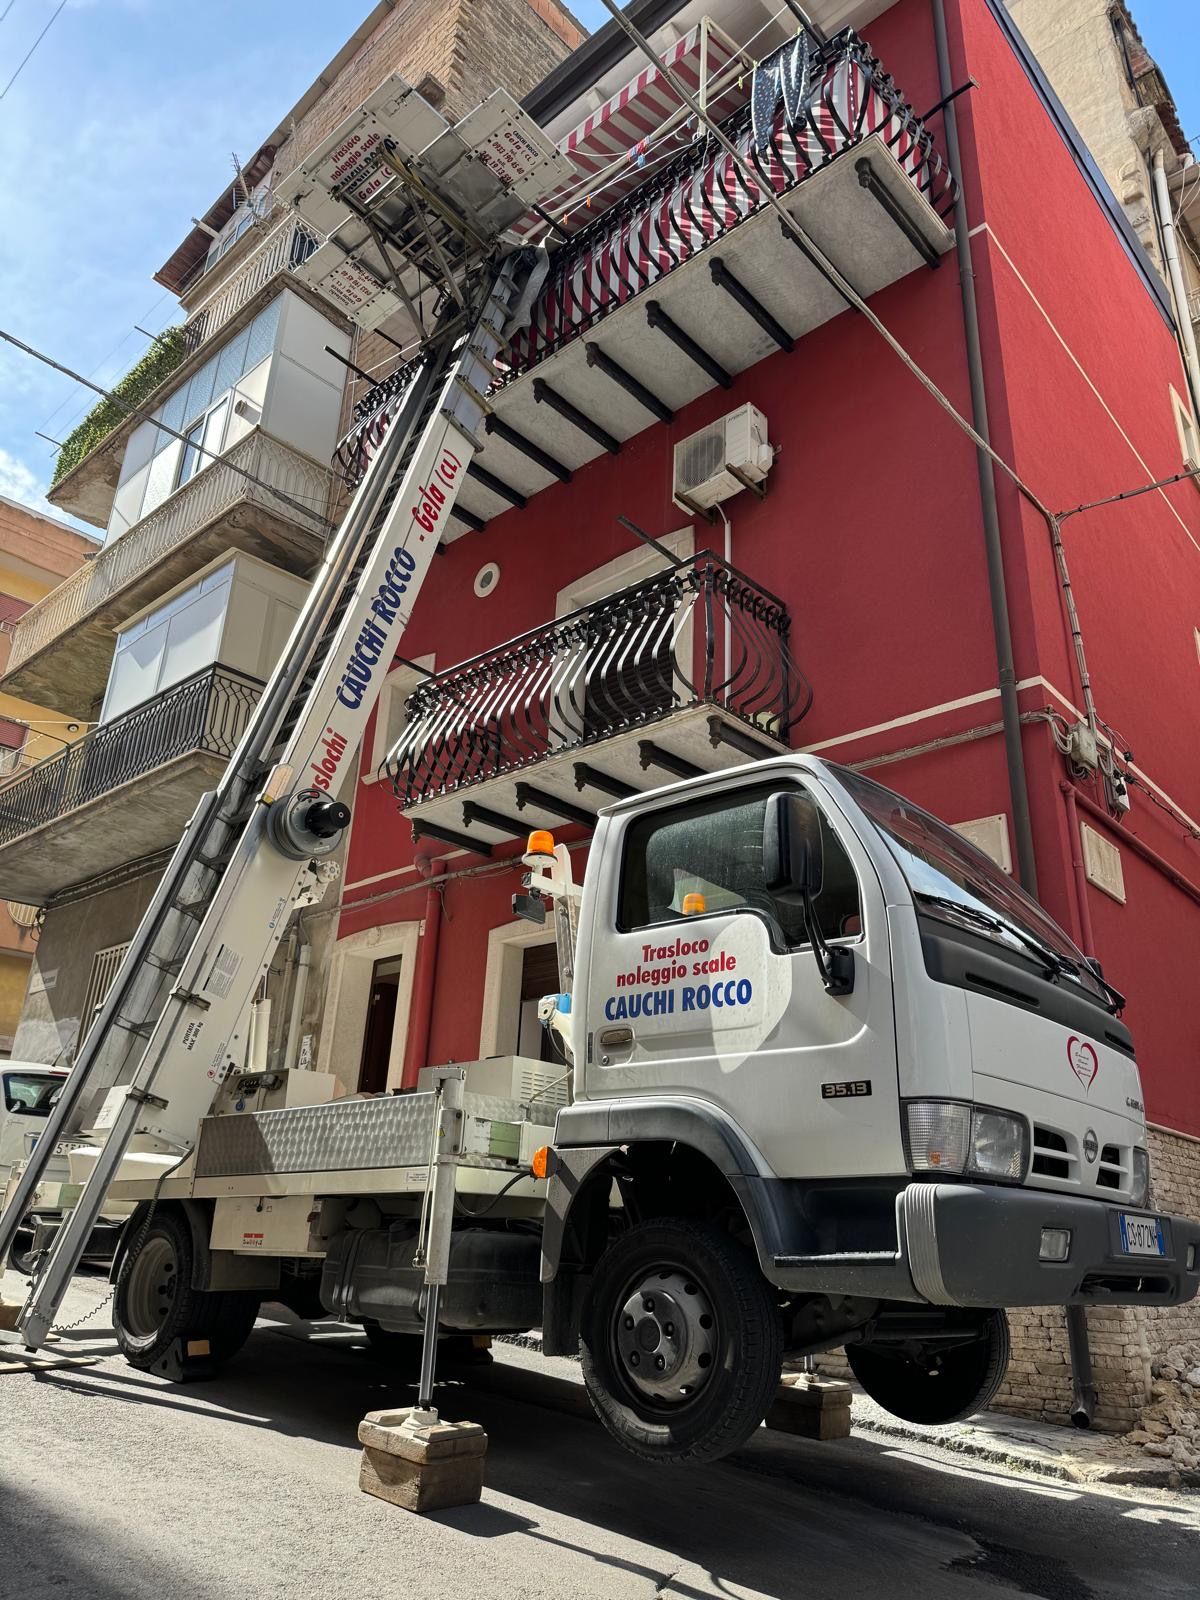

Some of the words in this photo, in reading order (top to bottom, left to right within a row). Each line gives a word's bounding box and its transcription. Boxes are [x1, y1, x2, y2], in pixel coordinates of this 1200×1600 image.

[504, 132, 522, 150] Gela
[512, 130, 527, 145] CAUCHI
[330, 151, 362, 181] noleggio
[360, 133, 381, 152] scale
[358, 179, 382, 200] Gela
[336, 618, 388, 710] CAUCHI
[371, 546, 416, 626] ROCCO
[412, 483, 446, 533] Gela
[434, 448, 462, 489] (CL)
[642, 938, 709, 963] Trasloco
[616, 960, 688, 987] noleggio
[692, 951, 737, 976] scale
[604, 988, 675, 1021] CAUCHI
[682, 978, 753, 1012] ROCCO
[824, 1082, 868, 1097] 35.13
